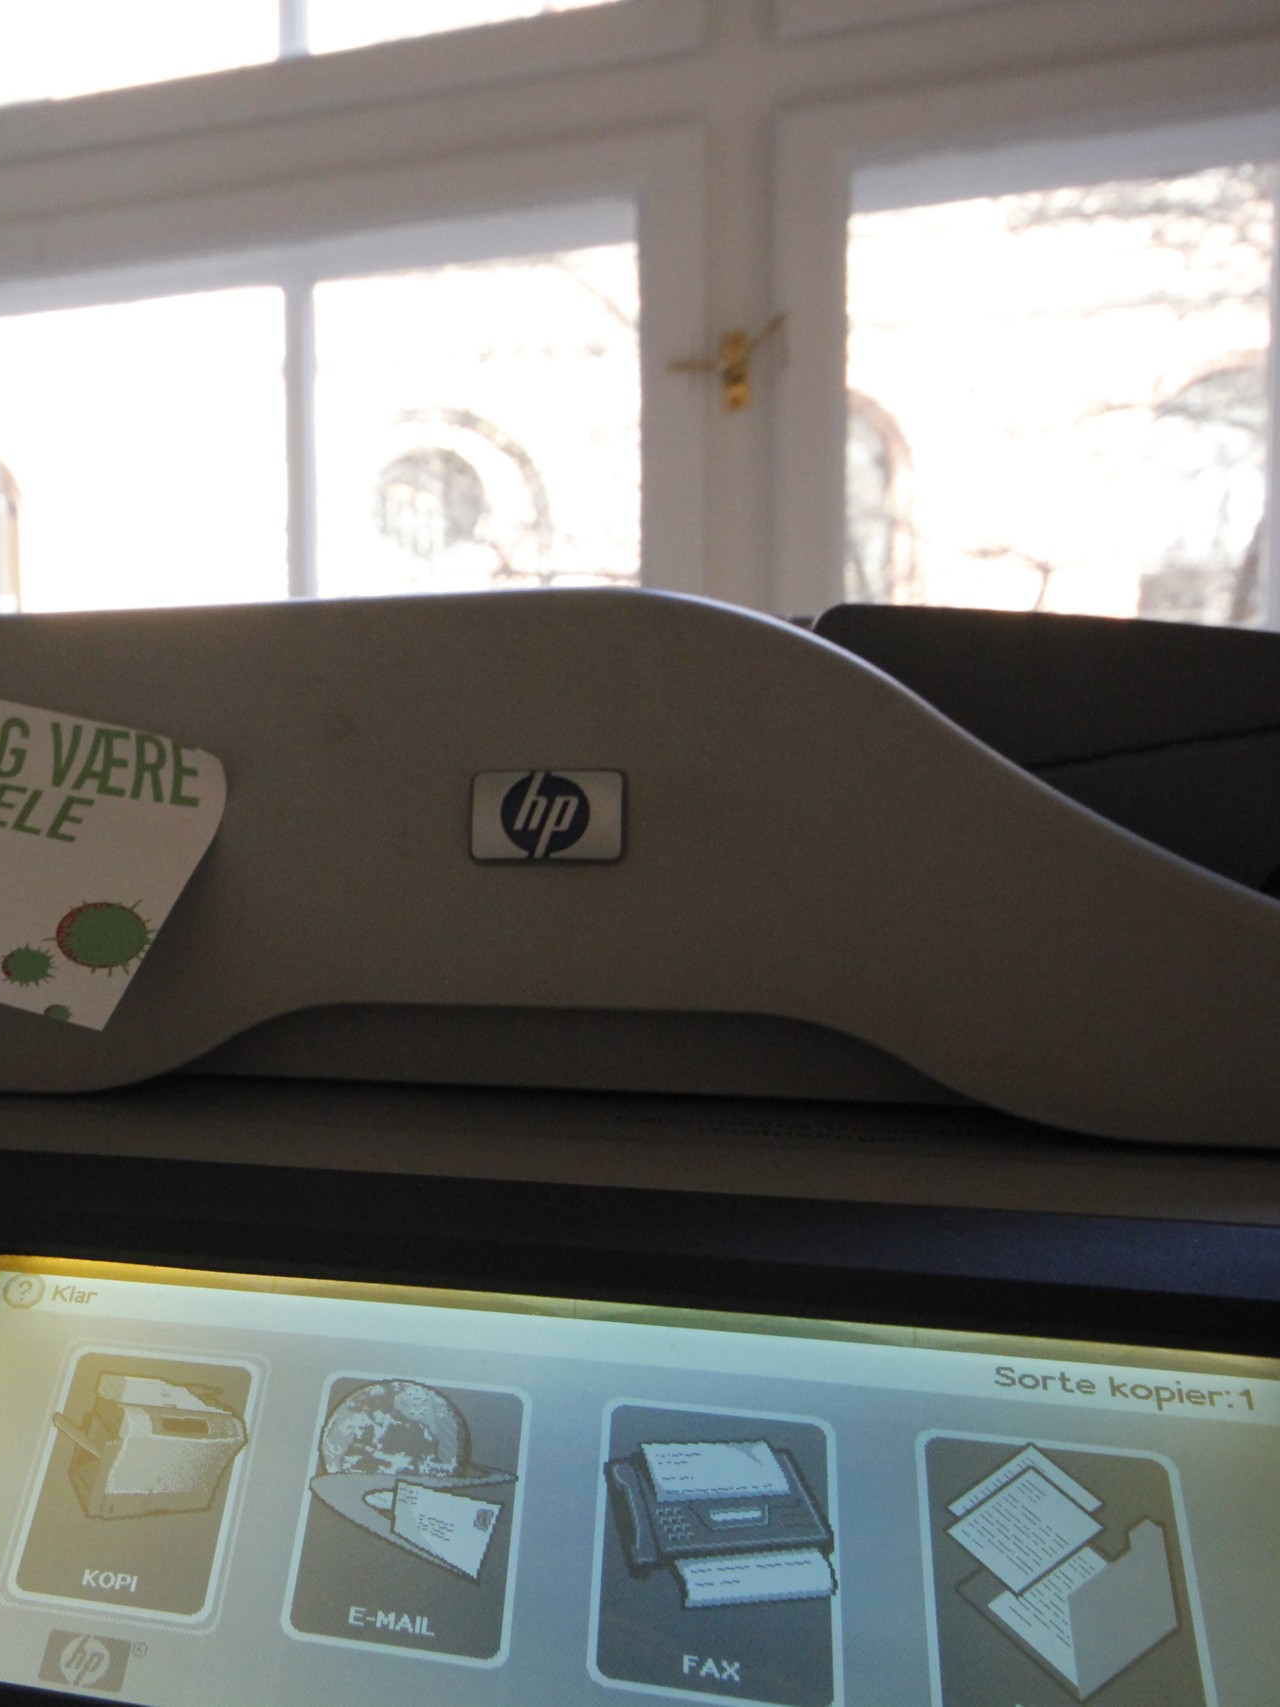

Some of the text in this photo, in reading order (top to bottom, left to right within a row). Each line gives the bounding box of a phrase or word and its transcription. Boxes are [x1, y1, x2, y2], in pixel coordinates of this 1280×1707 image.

[50, 721, 202, 808] VÆRE
[512, 770, 579, 859] hp
[51, 1284, 98, 1305] Klar
[993, 1365, 1097, 1396] Sorte
[81, 1567, 139, 1593] KOPI
[347, 1604, 436, 1637] E-MAIL
[681, 1653, 741, 1682] FAX
